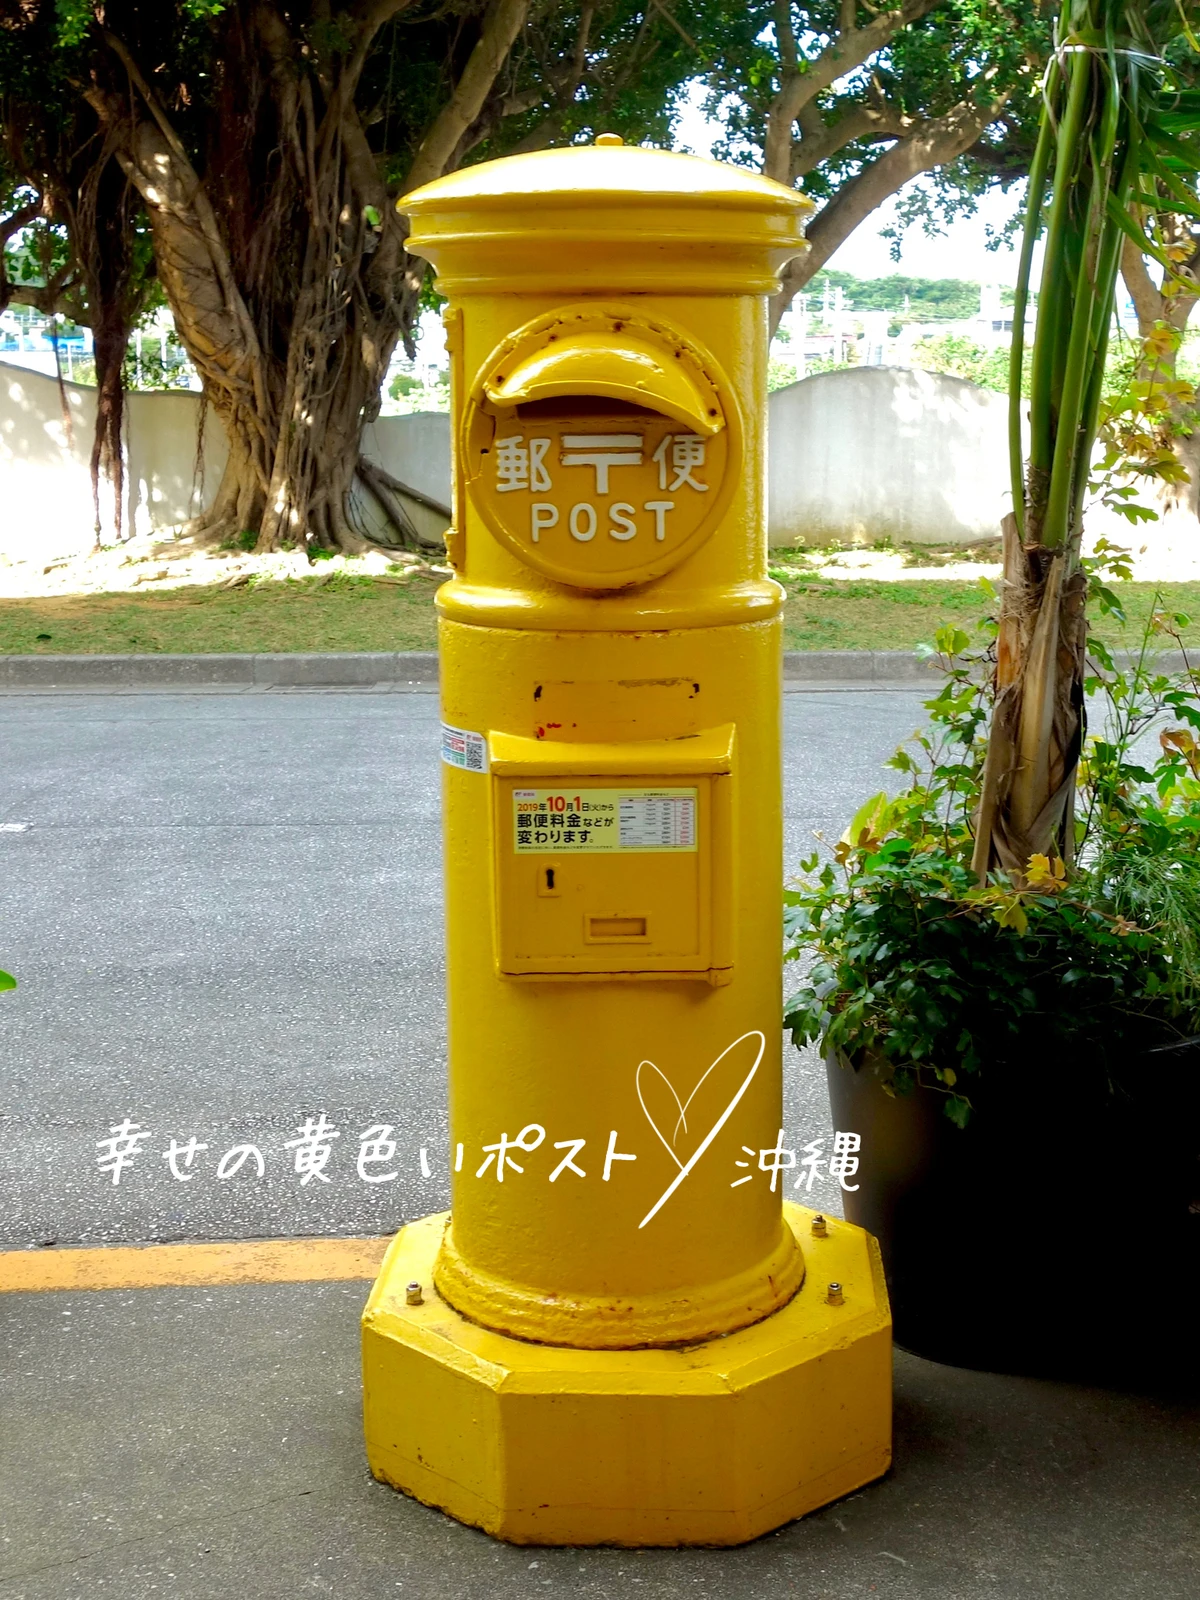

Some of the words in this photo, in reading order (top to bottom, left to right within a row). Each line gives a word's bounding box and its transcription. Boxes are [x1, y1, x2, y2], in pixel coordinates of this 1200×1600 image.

[531, 501, 675, 542] POST
[517, 813, 615, 828] 郵便料金などが
[517, 830, 594, 845] 変わります。
